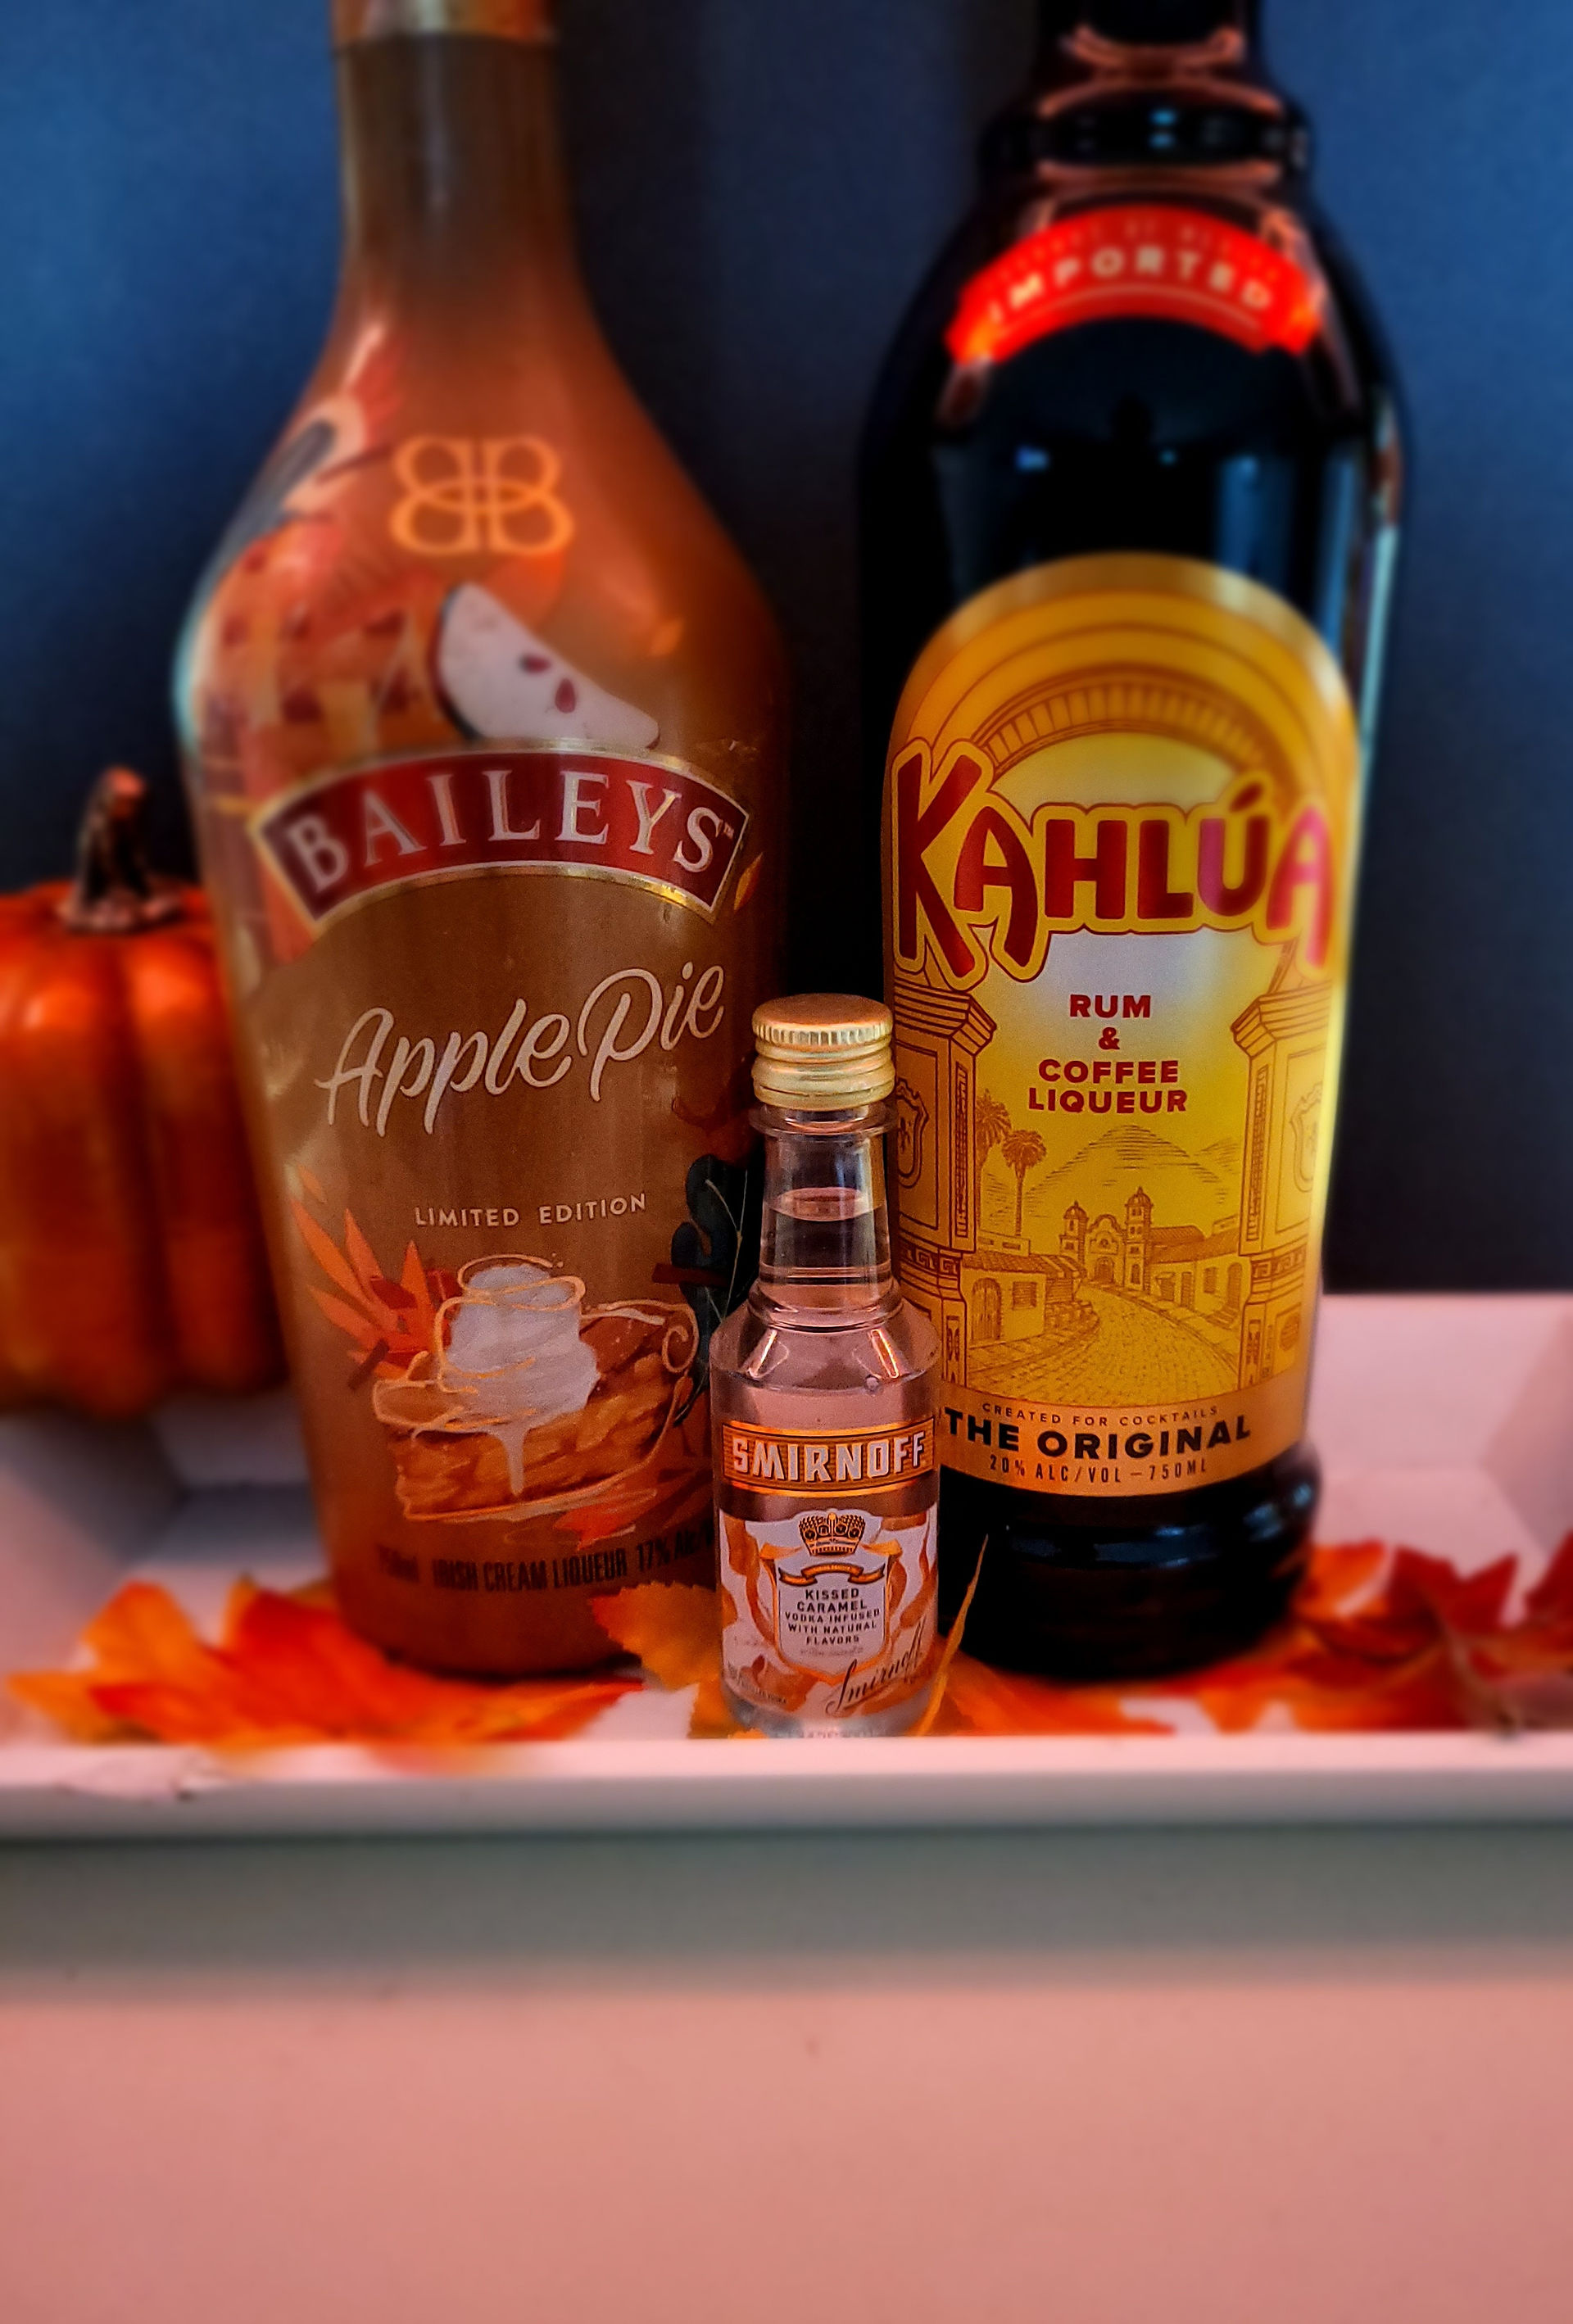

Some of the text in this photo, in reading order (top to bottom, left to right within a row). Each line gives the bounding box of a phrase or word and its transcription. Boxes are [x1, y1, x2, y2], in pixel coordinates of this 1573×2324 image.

[895, 750, 1335, 980] KAHLÚA
[1070, 994, 1152, 1018] RUM
[314, 961, 725, 1138] Apple Pie
[1098, 1026, 1122, 1050] &
[1038, 1058, 1179, 1084] COFFEE
[1027, 1087, 1188, 1114] LIQUEUR
[415, 1192, 647, 1228] LIMITED EDITION
[982, 1402, 1218, 1427] CREATED FOR COCKTAILS
[944, 1406, 1251, 1460] THE ORIGINAL
[732, 1430, 926, 1484] SMIRNOFF
[990, 1453, 1025, 1476] 20%
[1036, 1462, 1122, 1484] ALC/VOL
[1149, 1457, 1208, 1480] 750ML
[483, 1559, 548, 1592] CREAM
[551, 1547, 628, 1589] LIQUEUR
[796, 1598, 868, 1614] CARAMEL
[805, 1588, 859, 1601] KISSED
[785, 1608, 881, 1624] VODKA INFUSED
[787, 1620, 877, 1634] WITH NATURAL
